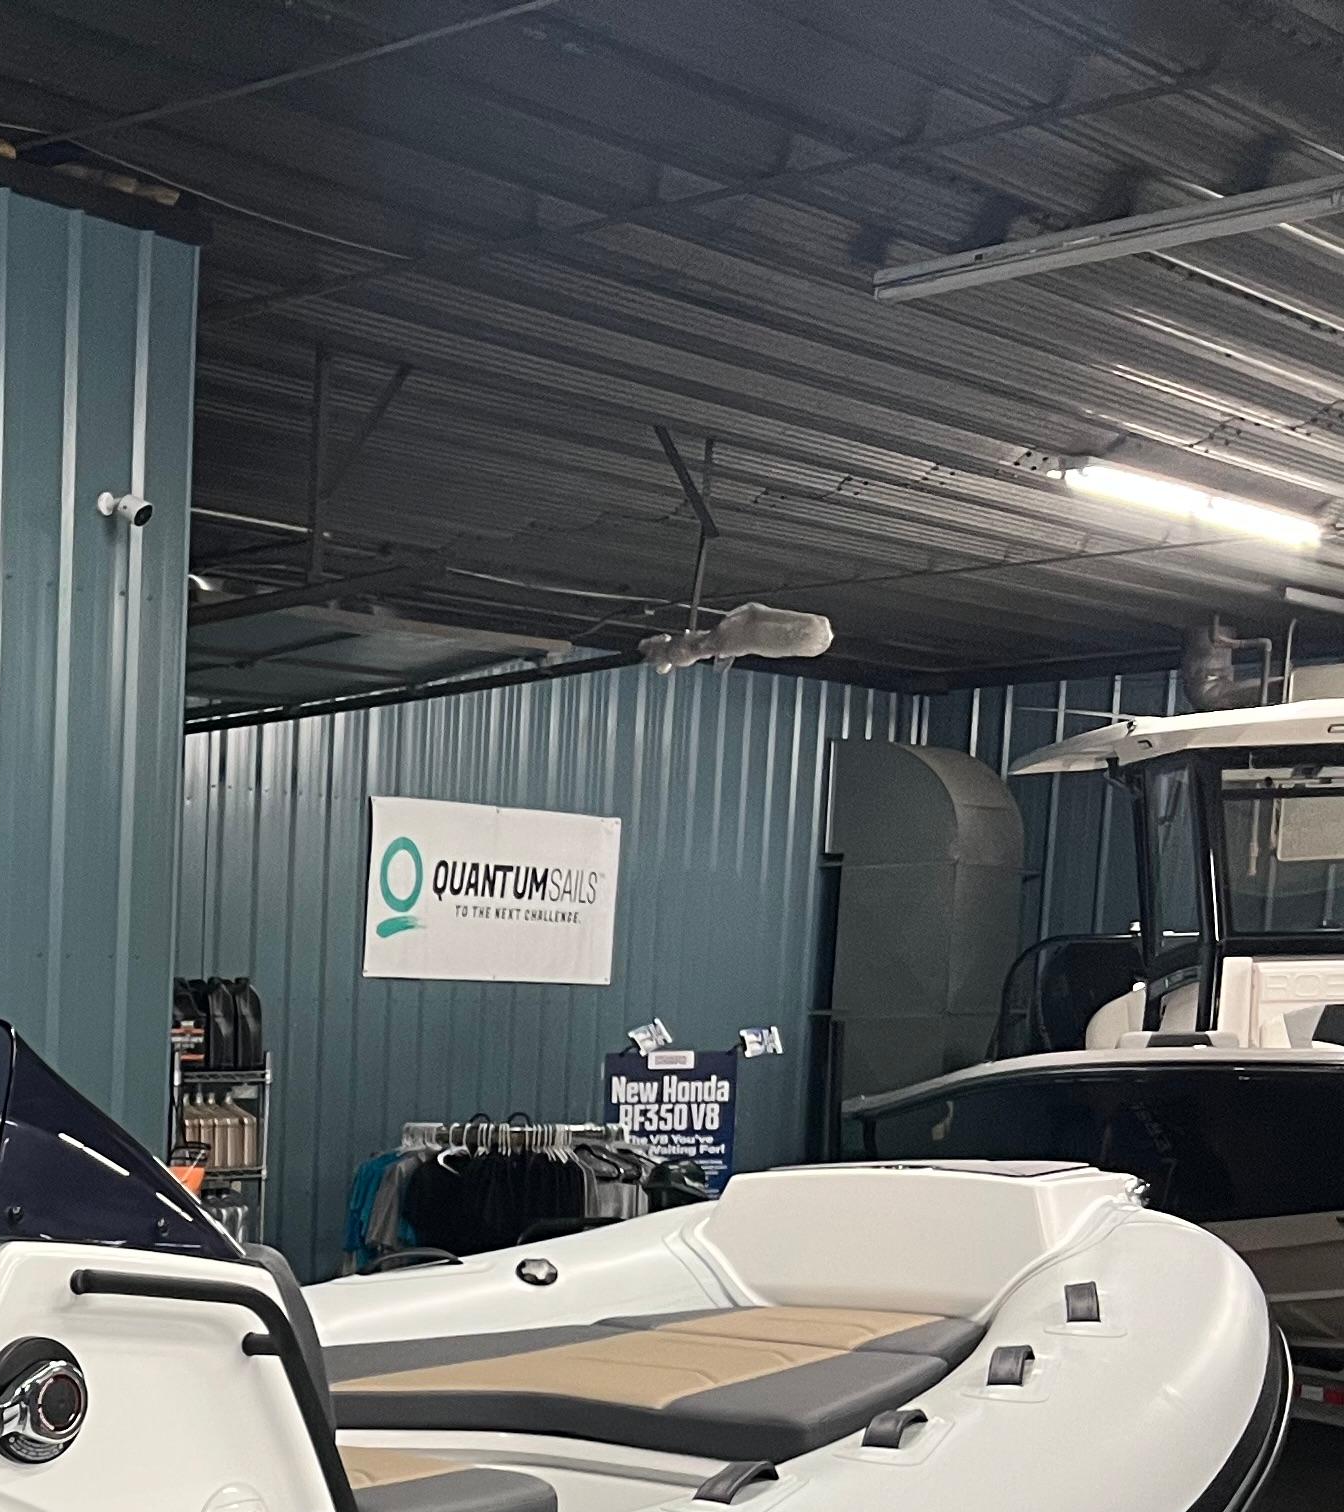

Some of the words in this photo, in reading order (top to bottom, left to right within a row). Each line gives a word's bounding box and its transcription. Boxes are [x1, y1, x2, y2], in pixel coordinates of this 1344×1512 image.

[455, 905, 468, 918] TO
[473, 906, 491, 919] THE
[495, 907, 520, 920] NEXT
[524, 909, 582, 924] CHALLENGE.
[611, 1075, 659, 1104] New
[662, 1074, 730, 1103] Honda
[619, 1103, 688, 1131] BF350
[690, 1103, 720, 1131] V8
